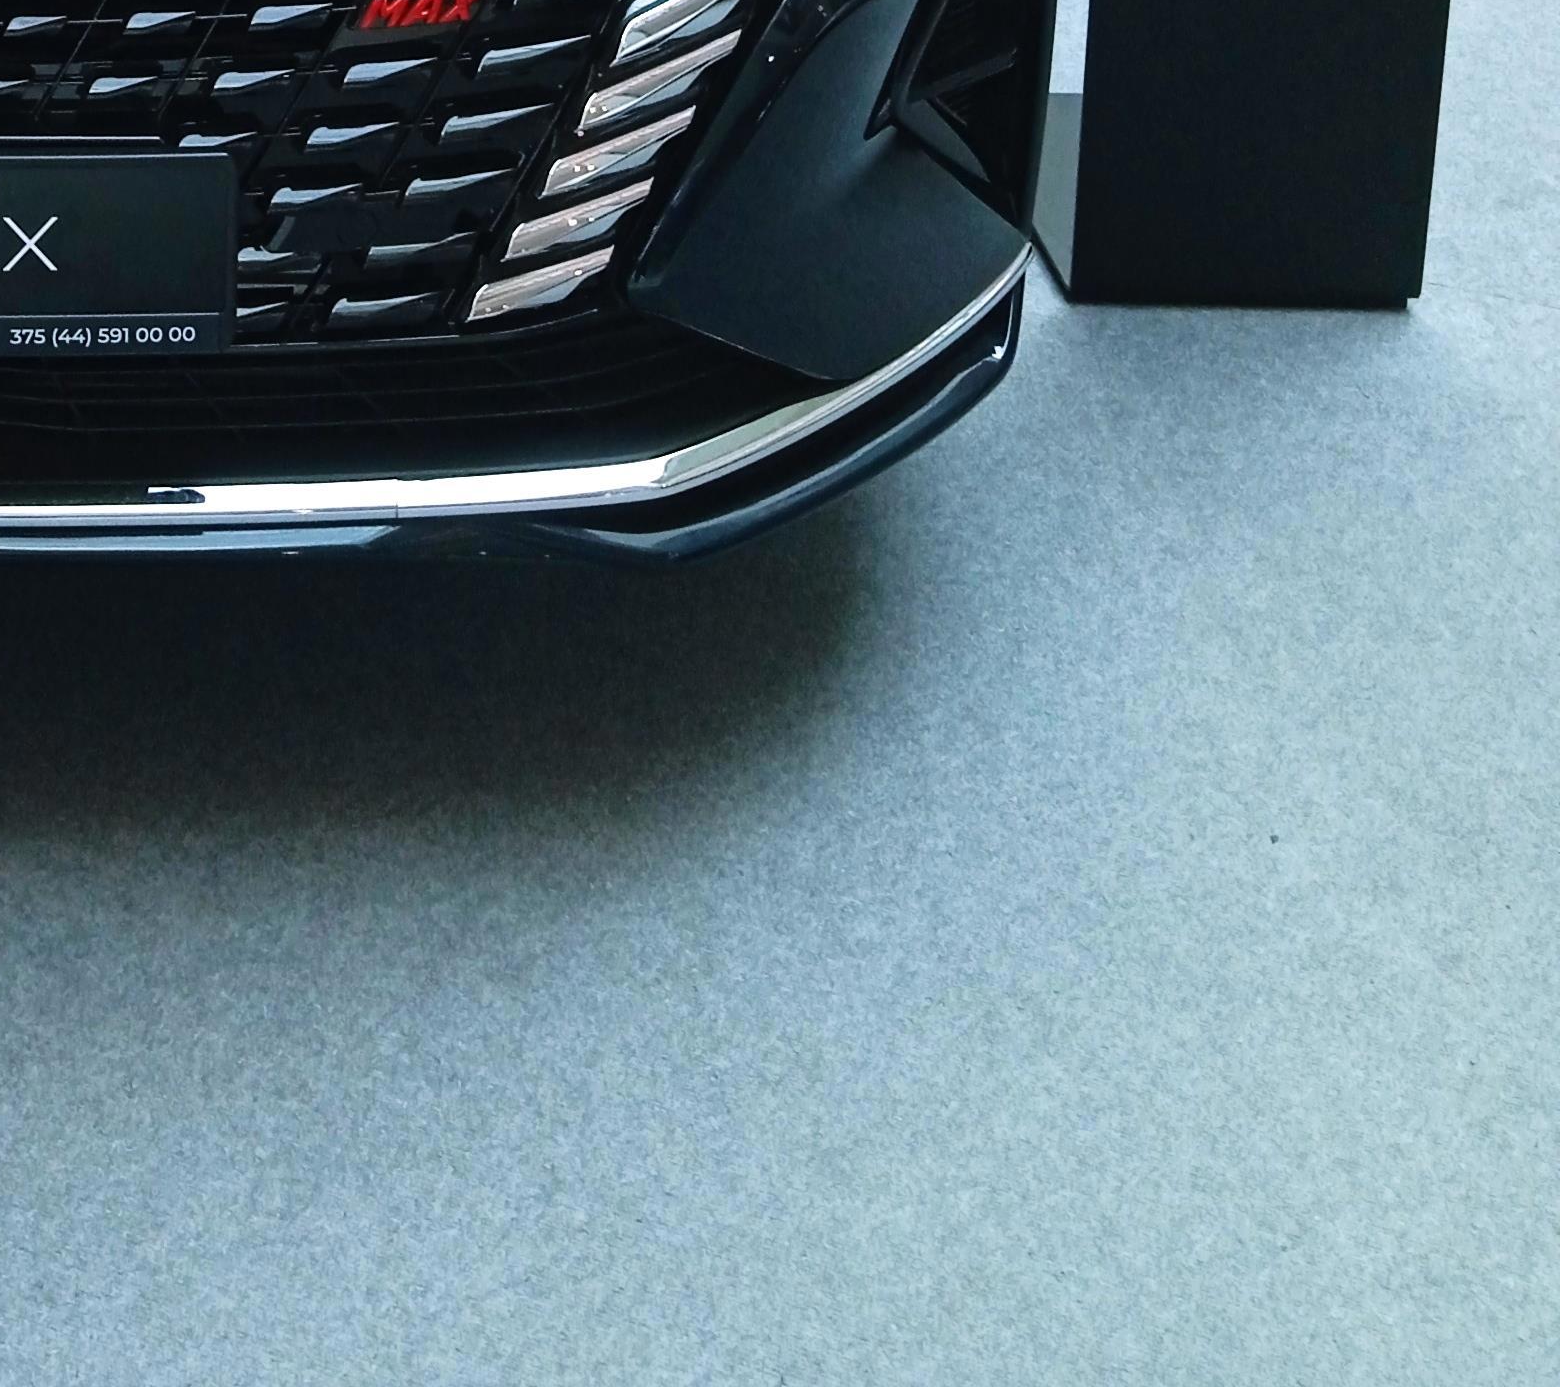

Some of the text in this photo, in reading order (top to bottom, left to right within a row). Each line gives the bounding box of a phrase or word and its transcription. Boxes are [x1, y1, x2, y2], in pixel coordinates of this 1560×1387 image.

[9, 326, 197, 348] 375 (44) 591 00 00
